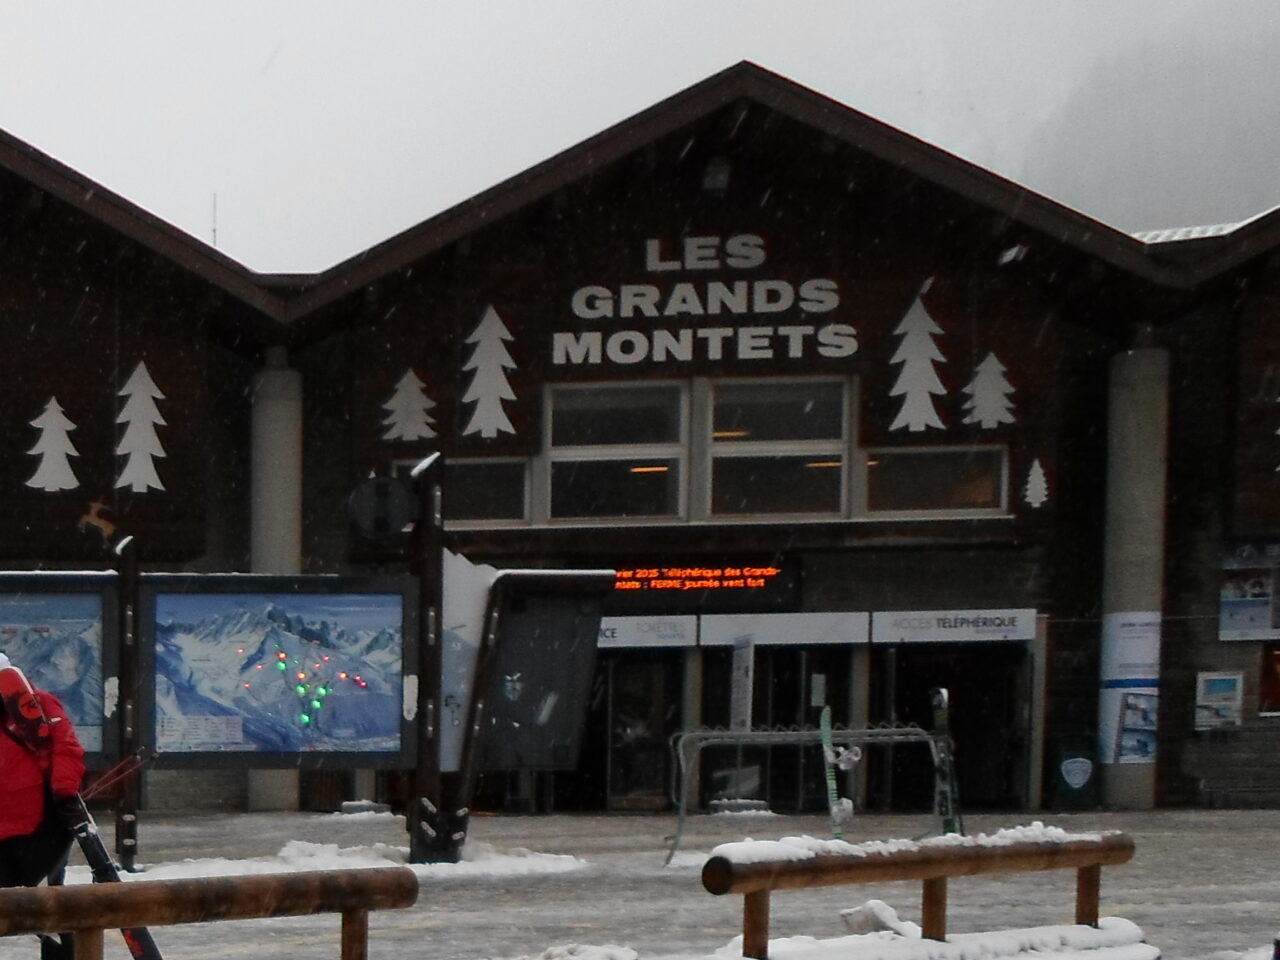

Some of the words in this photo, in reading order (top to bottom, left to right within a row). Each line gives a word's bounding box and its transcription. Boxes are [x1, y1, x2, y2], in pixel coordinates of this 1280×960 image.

[646, 234, 767, 272] LES
[571, 279, 840, 319] GRANDS
[552, 323, 859, 365] MONTETS
[722, 579, 744, 588] vent
[746, 577, 765, 588] fort
[724, 567, 741, 577] des
[935, 614, 1019, 629] TÉLÉPHÉRIQUE
